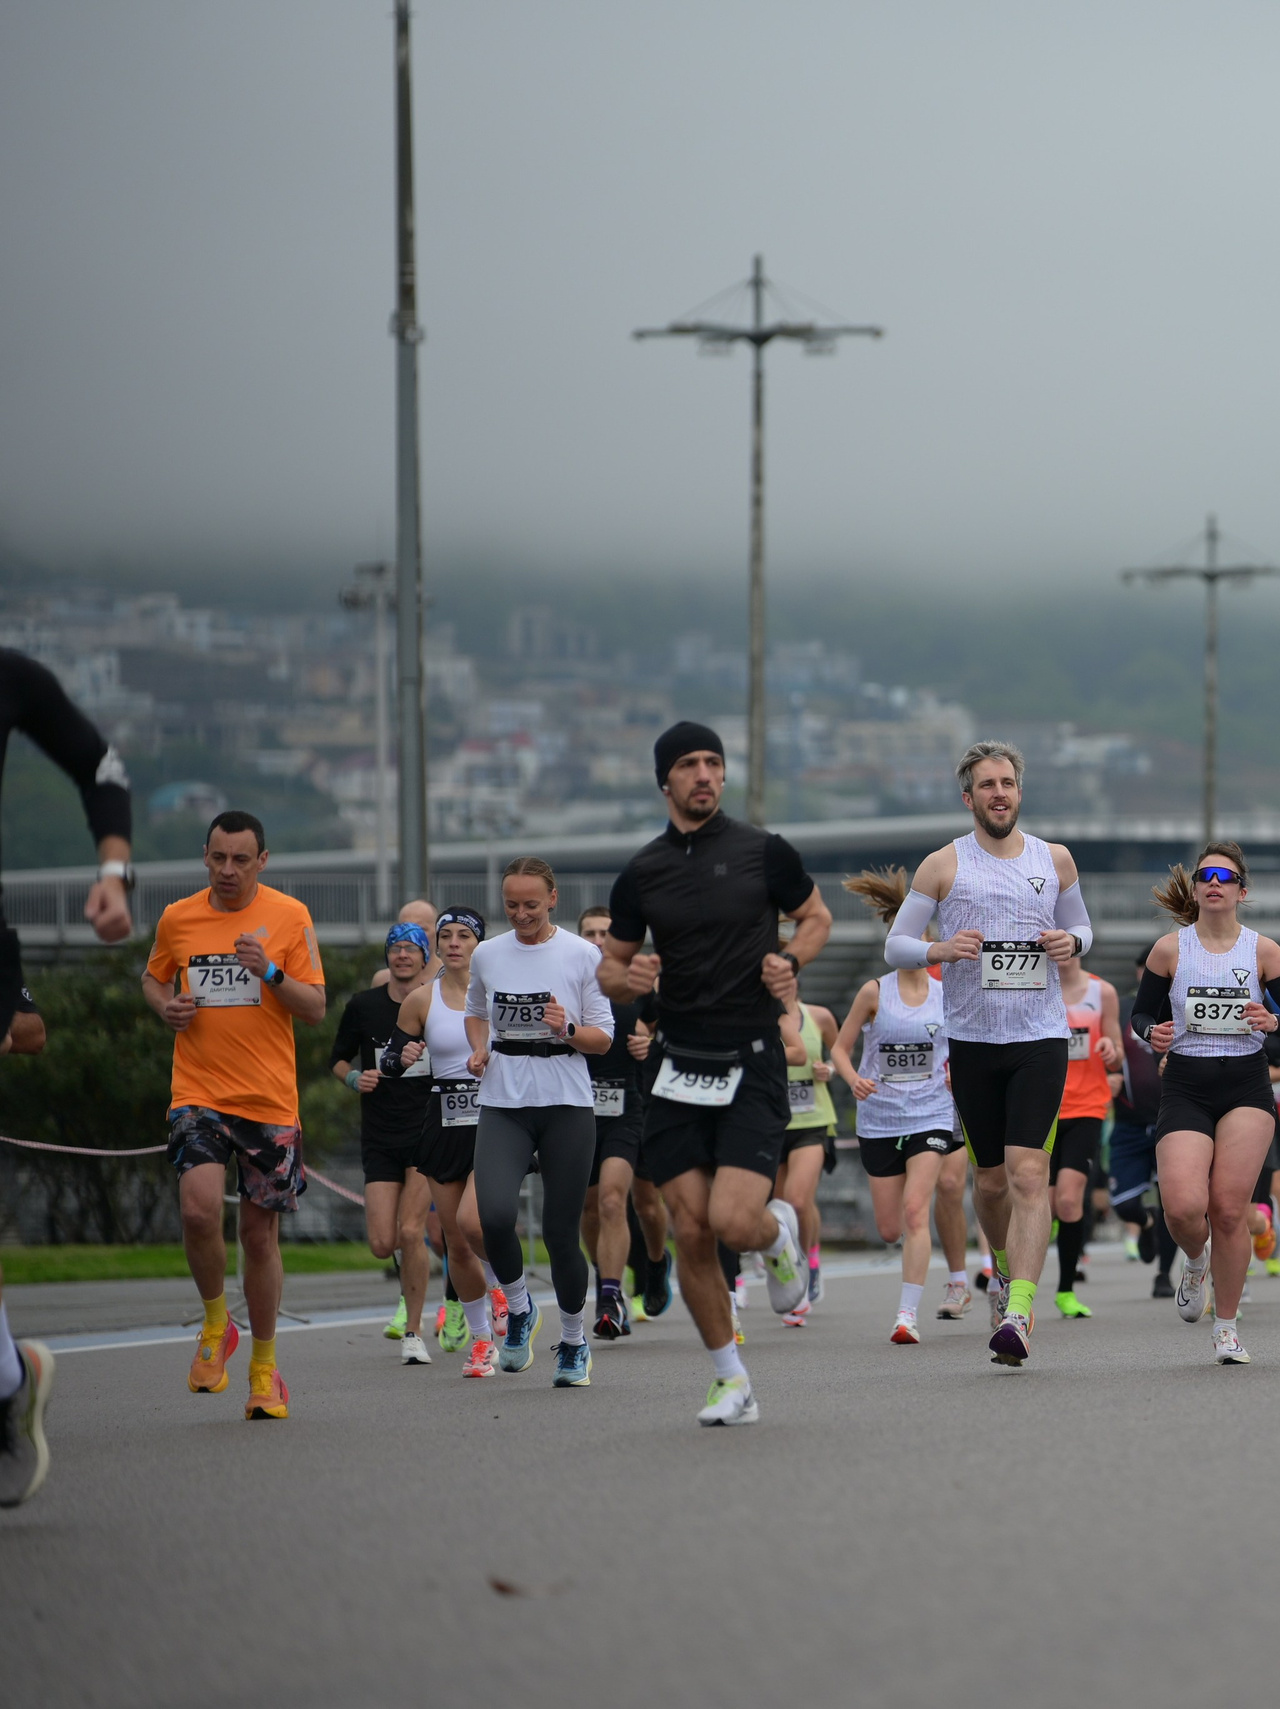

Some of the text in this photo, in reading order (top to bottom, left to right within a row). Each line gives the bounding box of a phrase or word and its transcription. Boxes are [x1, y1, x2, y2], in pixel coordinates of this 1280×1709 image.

[991, 954, 1040, 970] 6777
[198, 968, 250, 987] 7514
[498, 1005, 544, 1022] 7783
[1194, 1003, 1245, 1020] 8373
[887, 1053, 926, 1067] 6812
